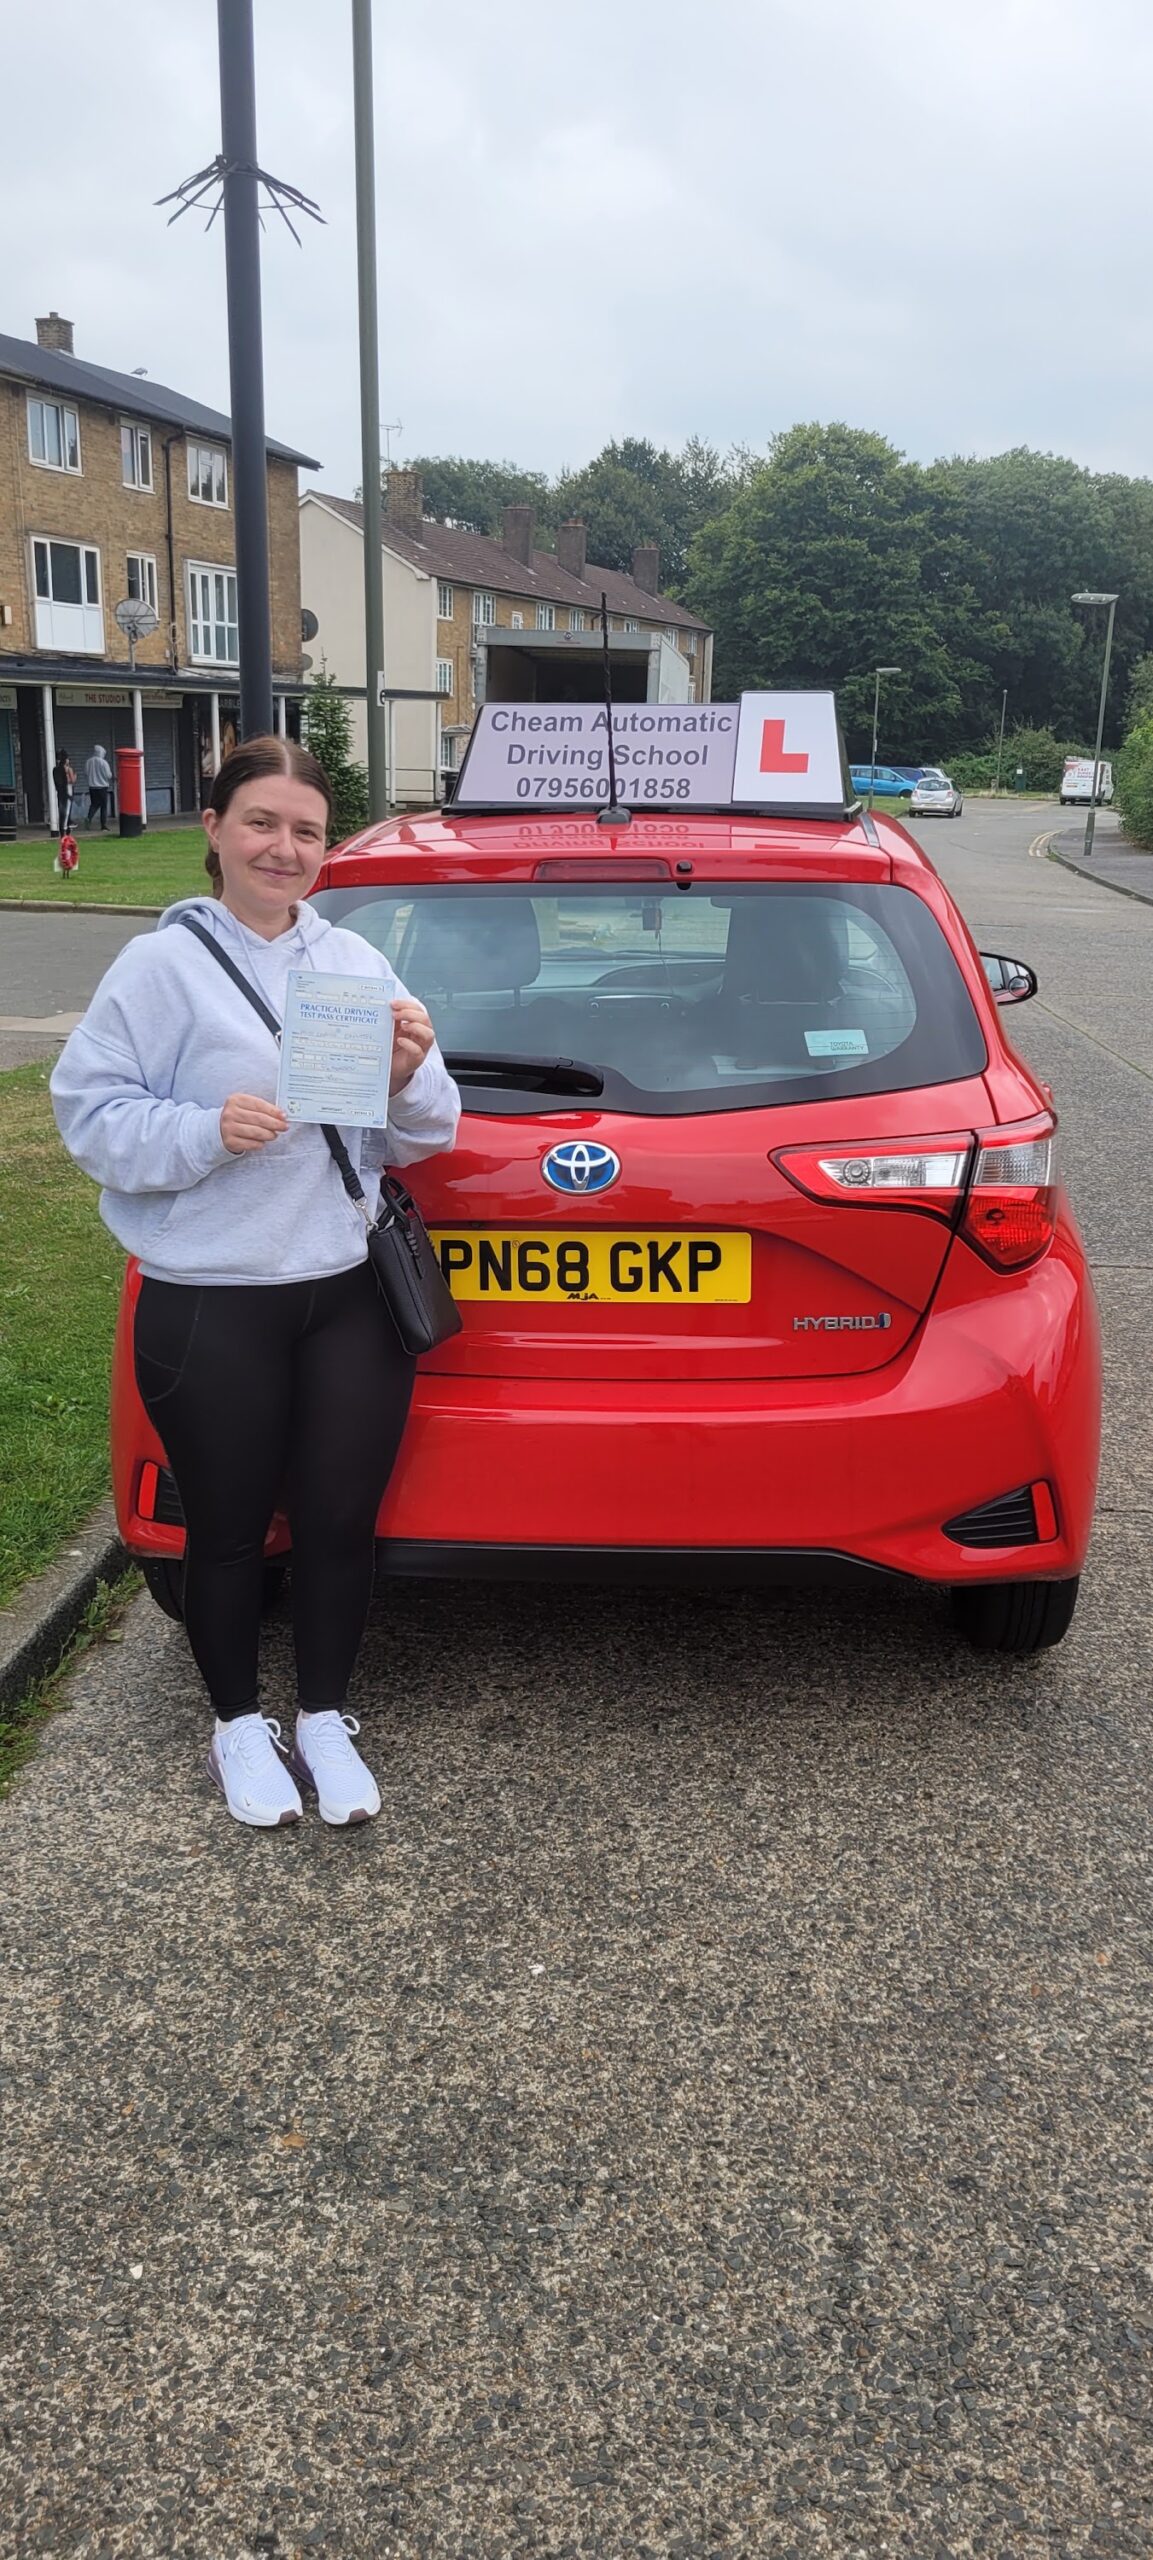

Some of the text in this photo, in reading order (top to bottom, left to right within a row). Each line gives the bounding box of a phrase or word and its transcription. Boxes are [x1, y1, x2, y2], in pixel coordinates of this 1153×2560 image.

[84, 693, 98, 703] THE
[99, 694, 121, 704] STUDIO
[491, 710, 733, 733] Cheam Automatic
[759, 719, 809, 773] L
[507, 744, 708, 771] Driving School
[516, 777, 691, 799] 07956001858
[300, 1003, 379, 1018] PRACTICAL DRIVING
[300, 1011, 316, 1019] TEST
[335, 1014, 378, 1025] CERTIFICATE
[440, 1239, 722, 1293] PN68 GKP
[793, 1316, 875, 1330] HYBRID
